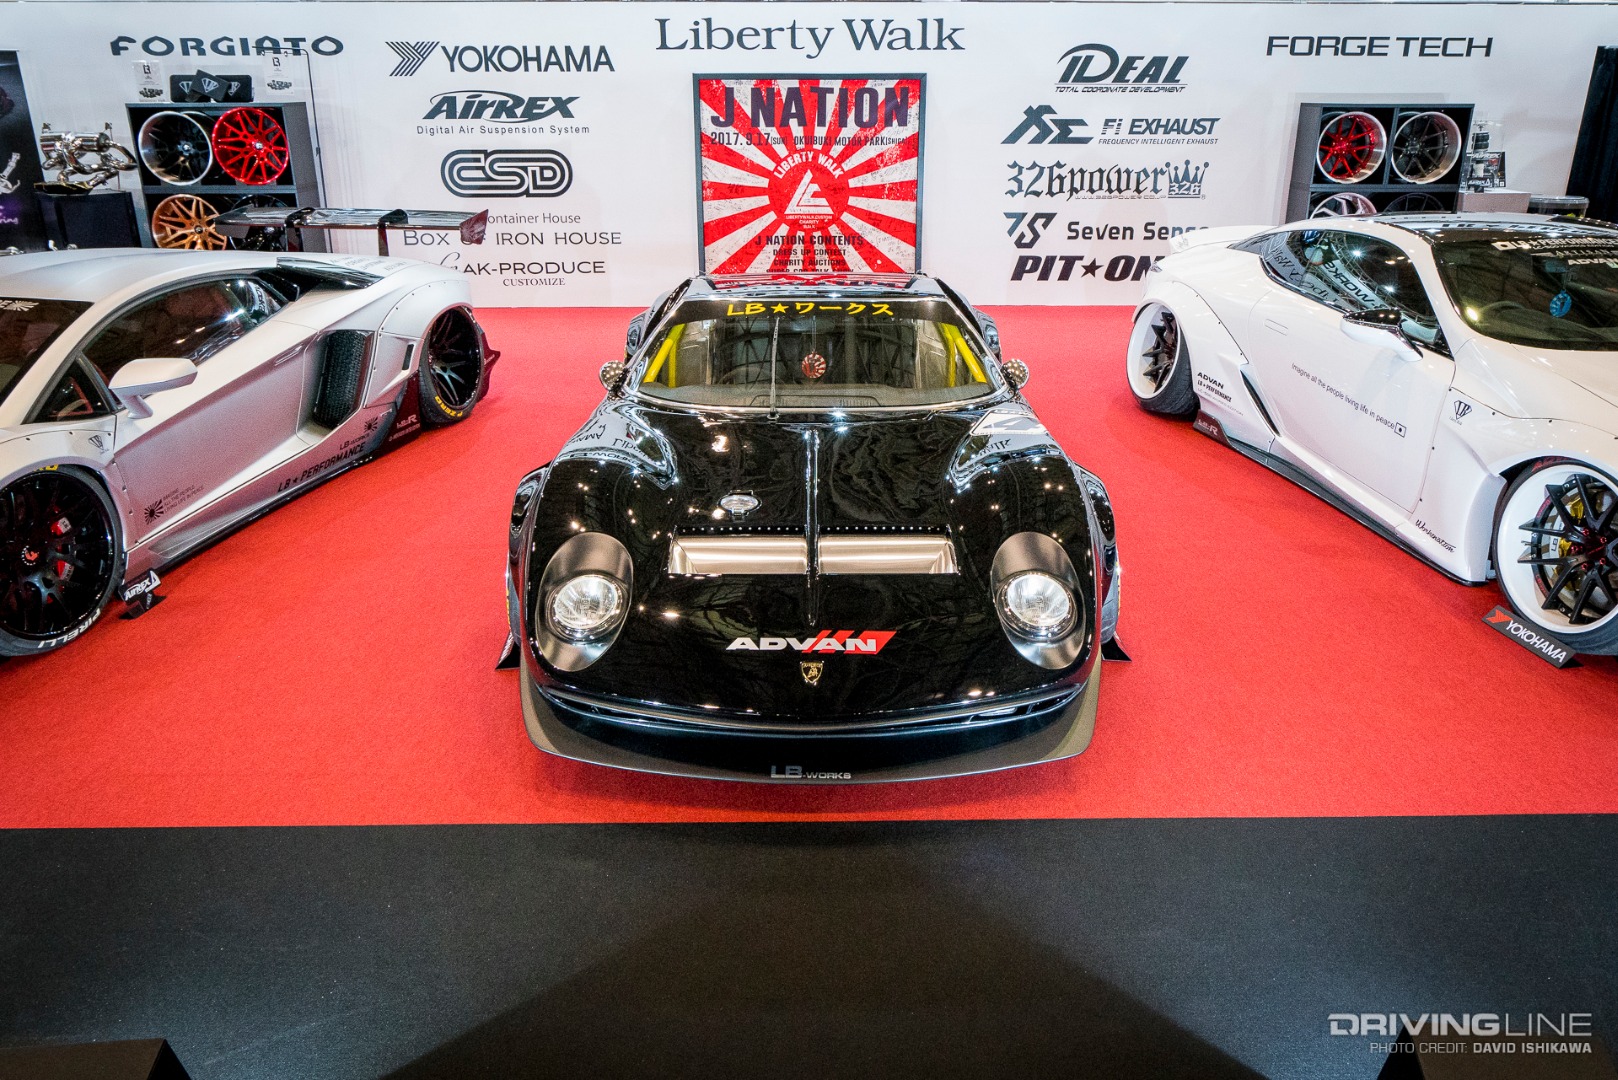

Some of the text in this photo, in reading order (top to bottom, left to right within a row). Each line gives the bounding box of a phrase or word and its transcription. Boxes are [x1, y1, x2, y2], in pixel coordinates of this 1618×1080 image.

[109, 35, 344, 57] FORGIATO
[654, 17, 966, 59] Liberty Walk
[1266, 36, 1494, 58] FORGE TECH
[440, 44, 616, 73] YOKOHAMA
[711, 86, 910, 128] J NATION
[416, 125, 590, 137] Digital Air Suspension System
[1127, 117, 1222, 136] EXHAUST
[440, 149, 573, 198] CSD
[773, 151, 845, 179] LIBERTY WALK
[487, 213, 581, 224] ontainer House
[496, 232, 544, 246] IRON
[555, 231, 622, 246] HOUSE
[766, 235, 805, 246] NATION
[809, 235, 864, 246] CONTENTS
[1066, 221, 1135, 241] Seven
[463, 260, 606, 275] AK-PRODUCE
[502, 277, 566, 287] CUSTOMIZE
[1197, 372, 1225, 390] ADVAN
[1310, 374, 1318, 384] all
[1317, 378, 1326, 389] the
[1326, 384, 1345, 400] people
[1344, 393, 1359, 411] living
[1359, 402, 1369, 415] life
[1369, 409, 1376, 418] in
[1375, 414, 1396, 430] peace
[299, 441, 366, 483] PERFORMANCE
[37, 608, 100, 649] PIRELLI
[725, 637, 877, 652] ADVAN
[1505, 619, 1568, 663] YOKOHAMA
